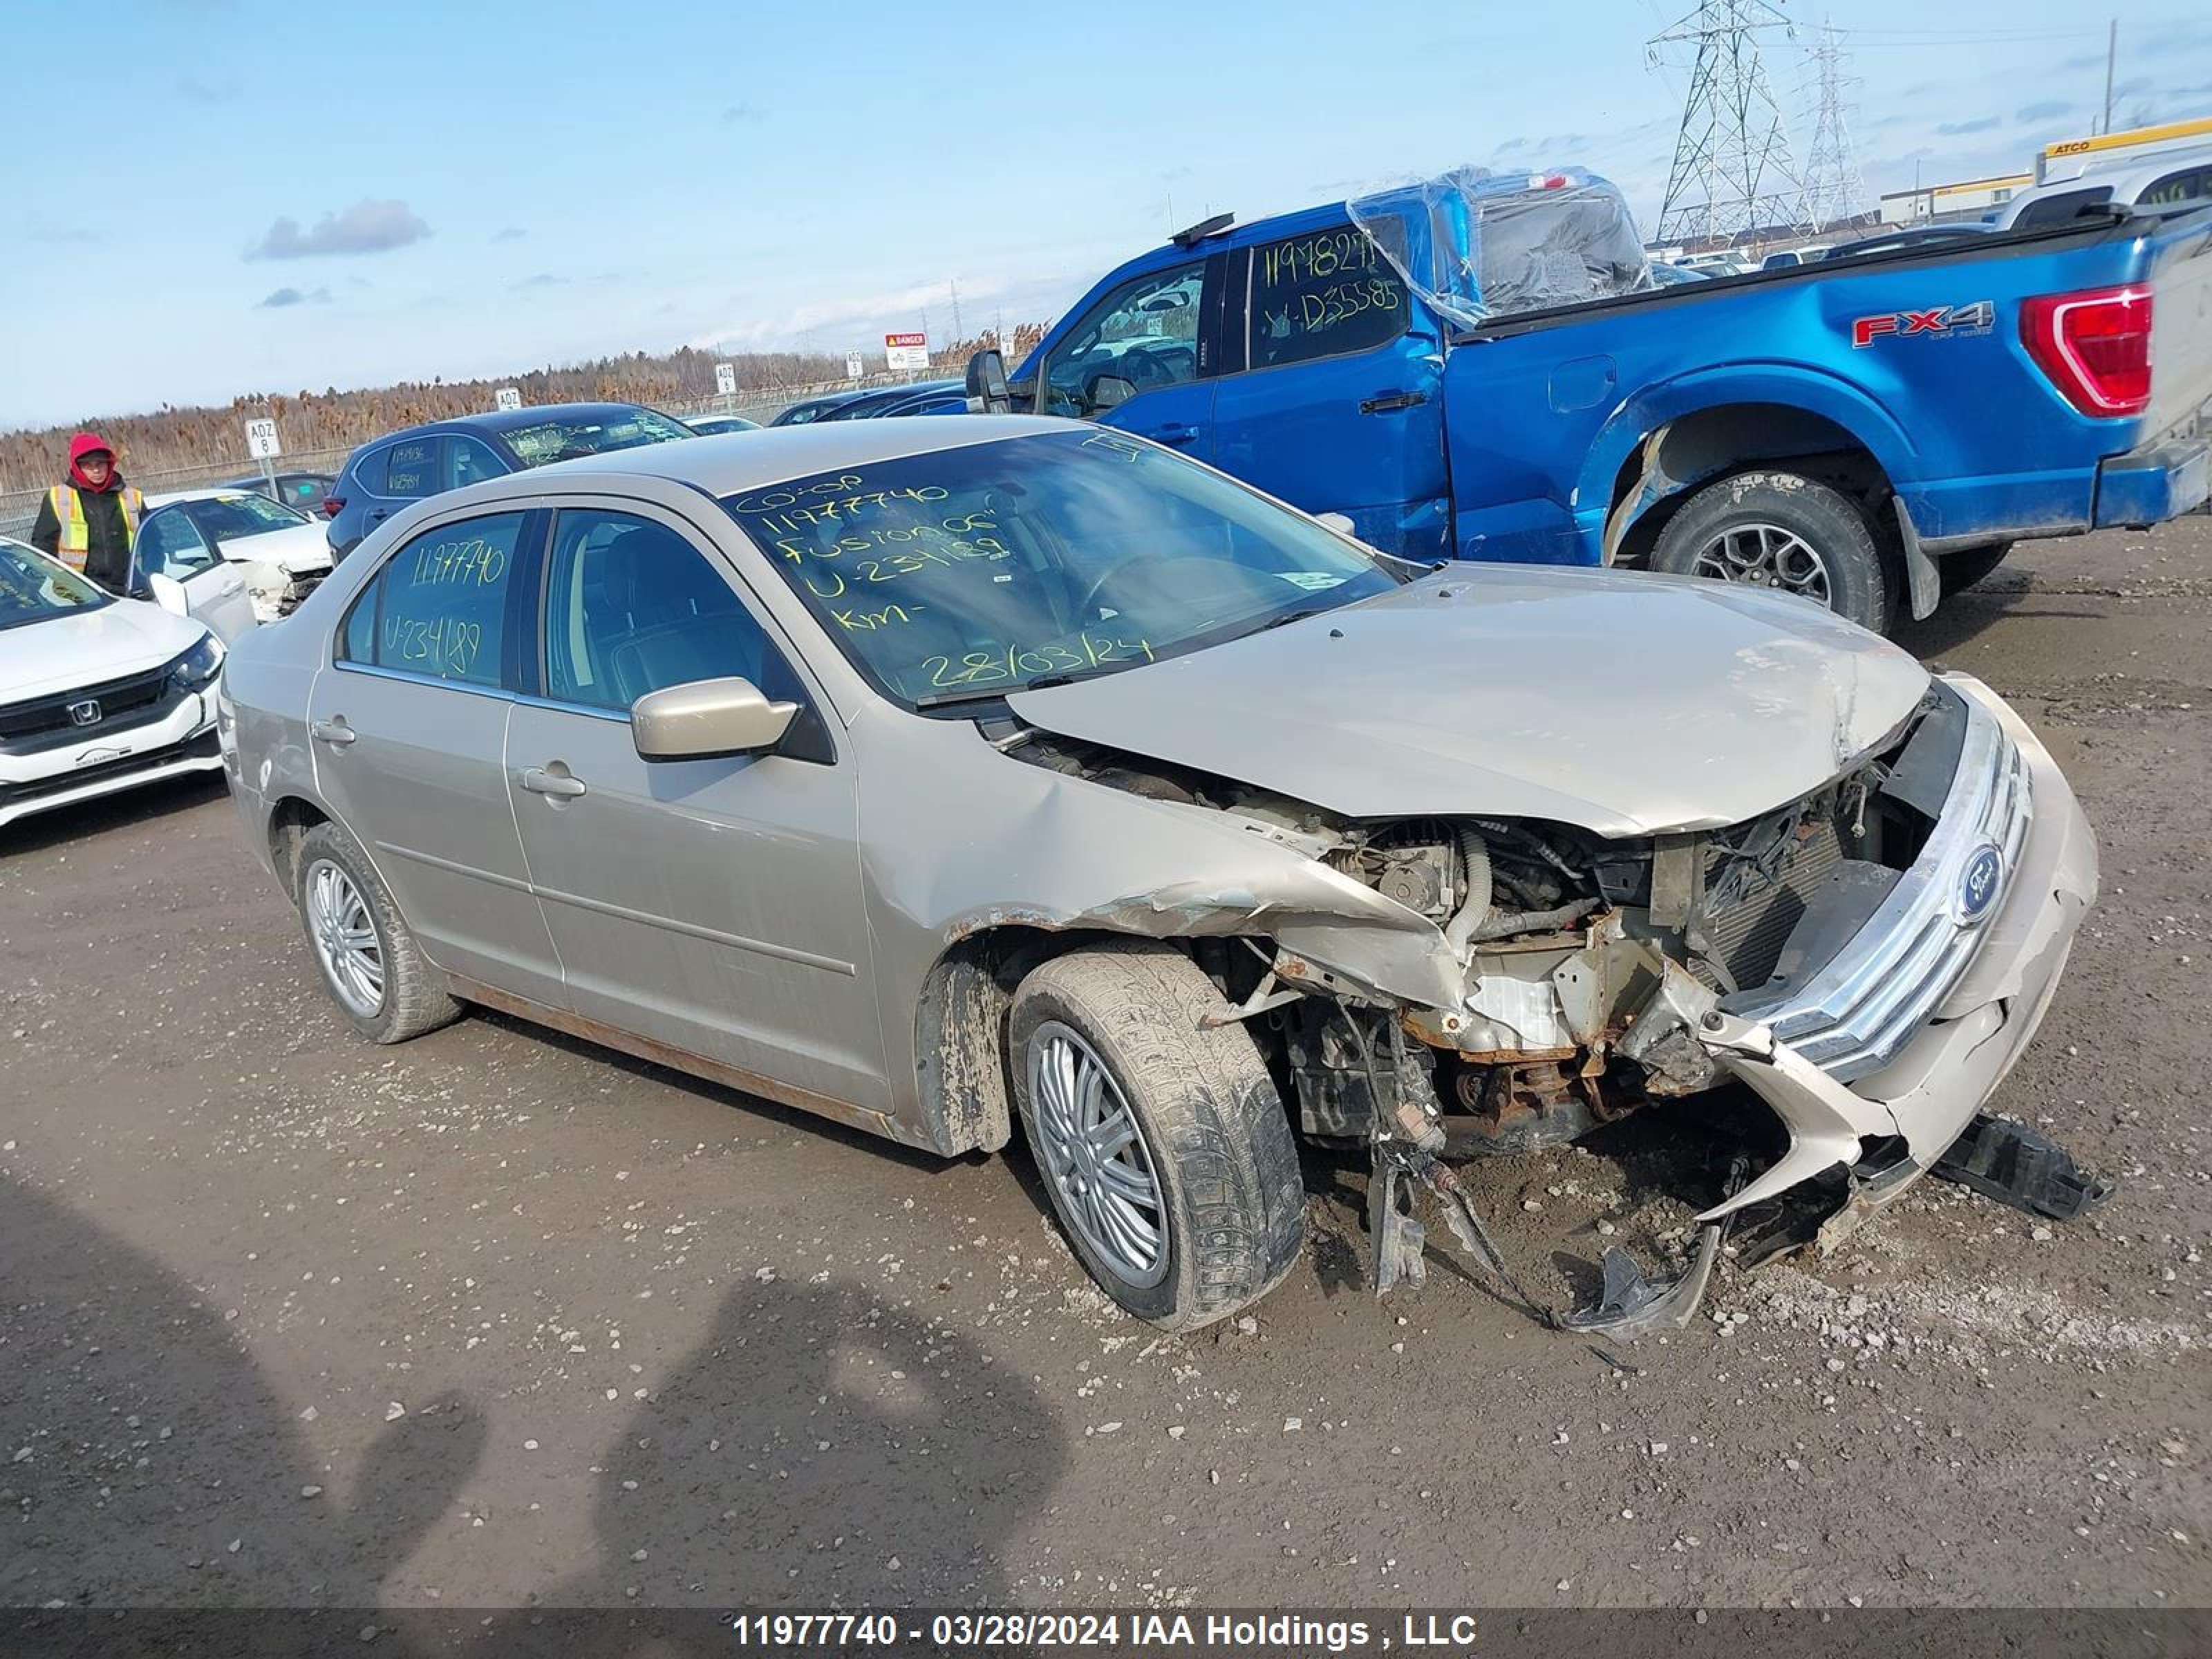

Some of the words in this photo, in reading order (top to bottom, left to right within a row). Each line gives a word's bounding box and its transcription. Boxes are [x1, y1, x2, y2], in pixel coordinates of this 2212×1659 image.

[2054, 141, 2090, 153] ATCO
[1853, 300, 1995, 349] FX4
[762, 486, 949, 534] 11977740
[413, 539, 505, 588] 11977740
[921, 617, 1156, 687] 28/03/24
